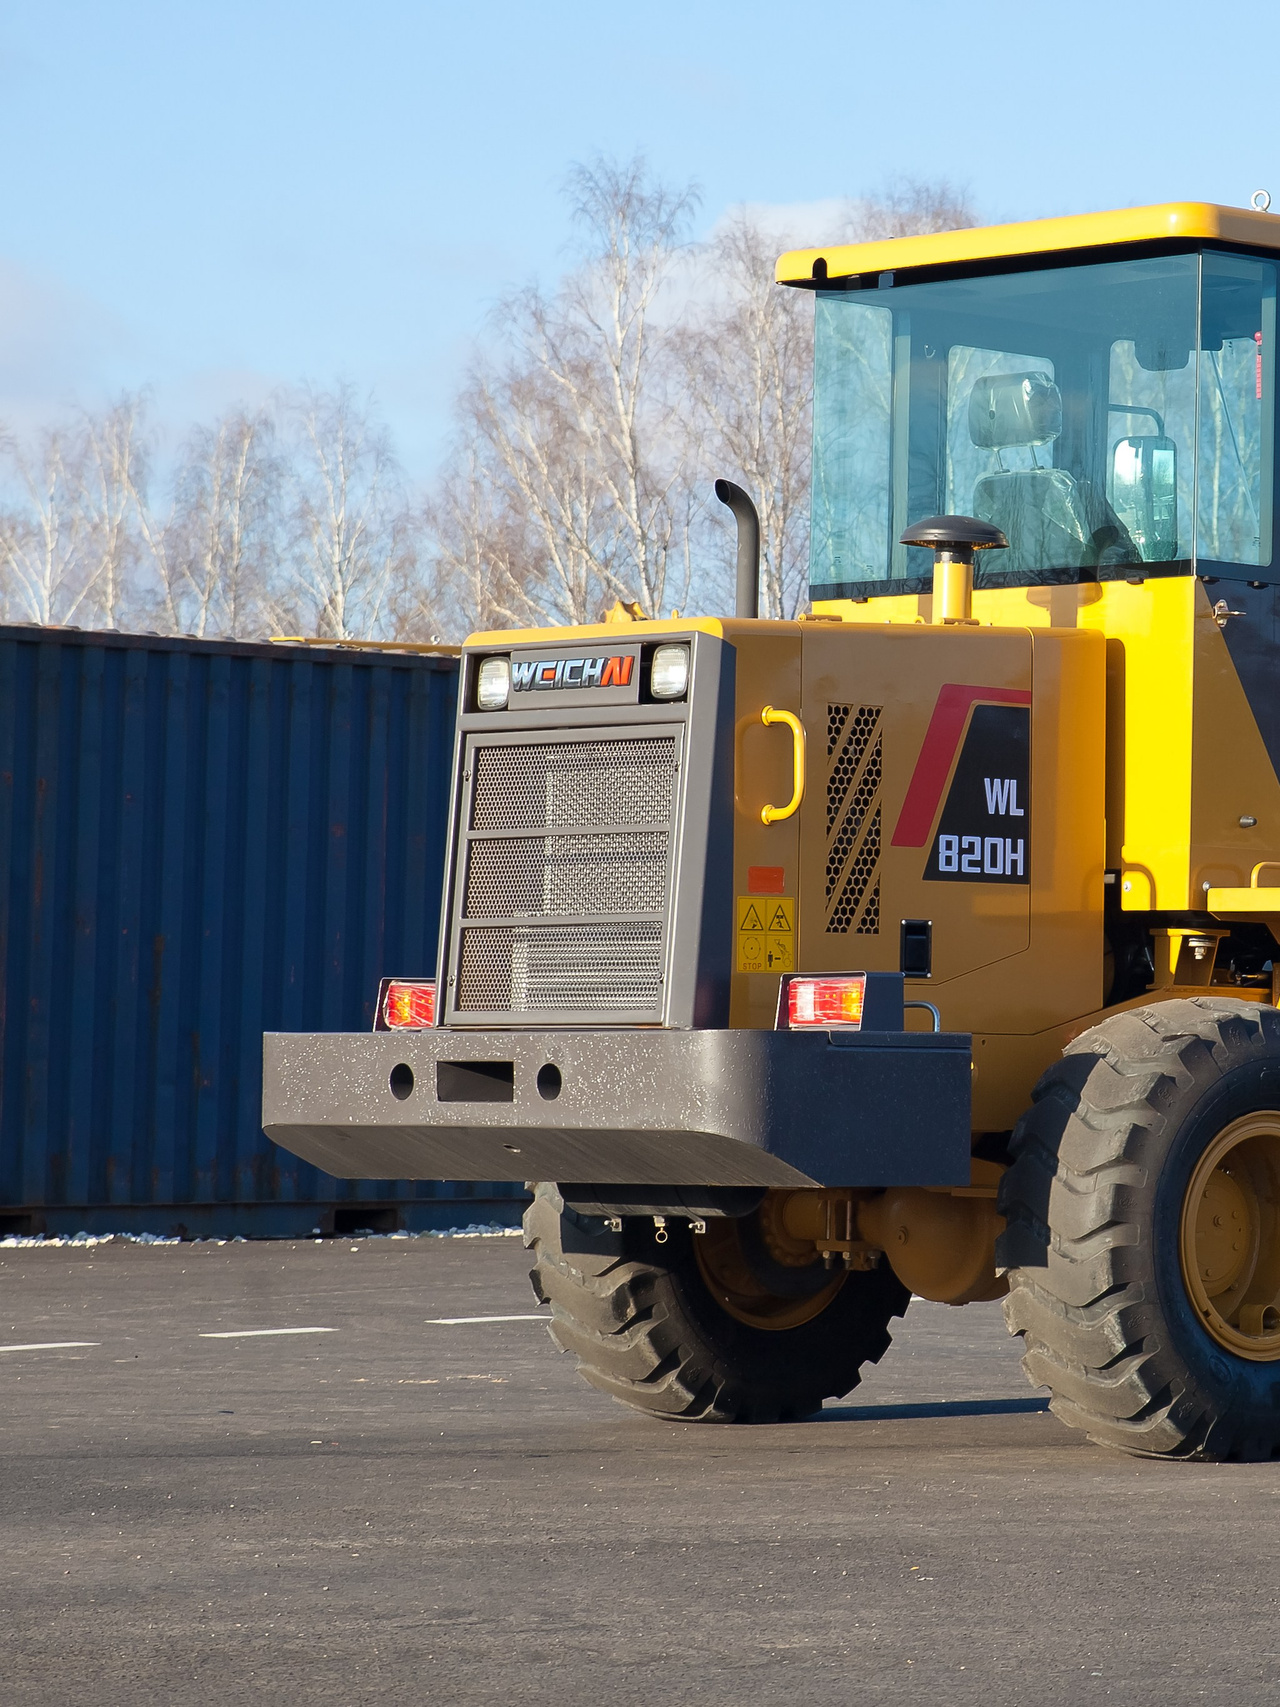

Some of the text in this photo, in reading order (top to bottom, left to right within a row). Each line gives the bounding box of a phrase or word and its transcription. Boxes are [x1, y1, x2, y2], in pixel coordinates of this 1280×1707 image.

[512, 656, 635, 692] WEICHAI
[984, 777, 1025, 816] WL
[938, 834, 1024, 876] 820H
[742, 962, 762, 971] STOP
